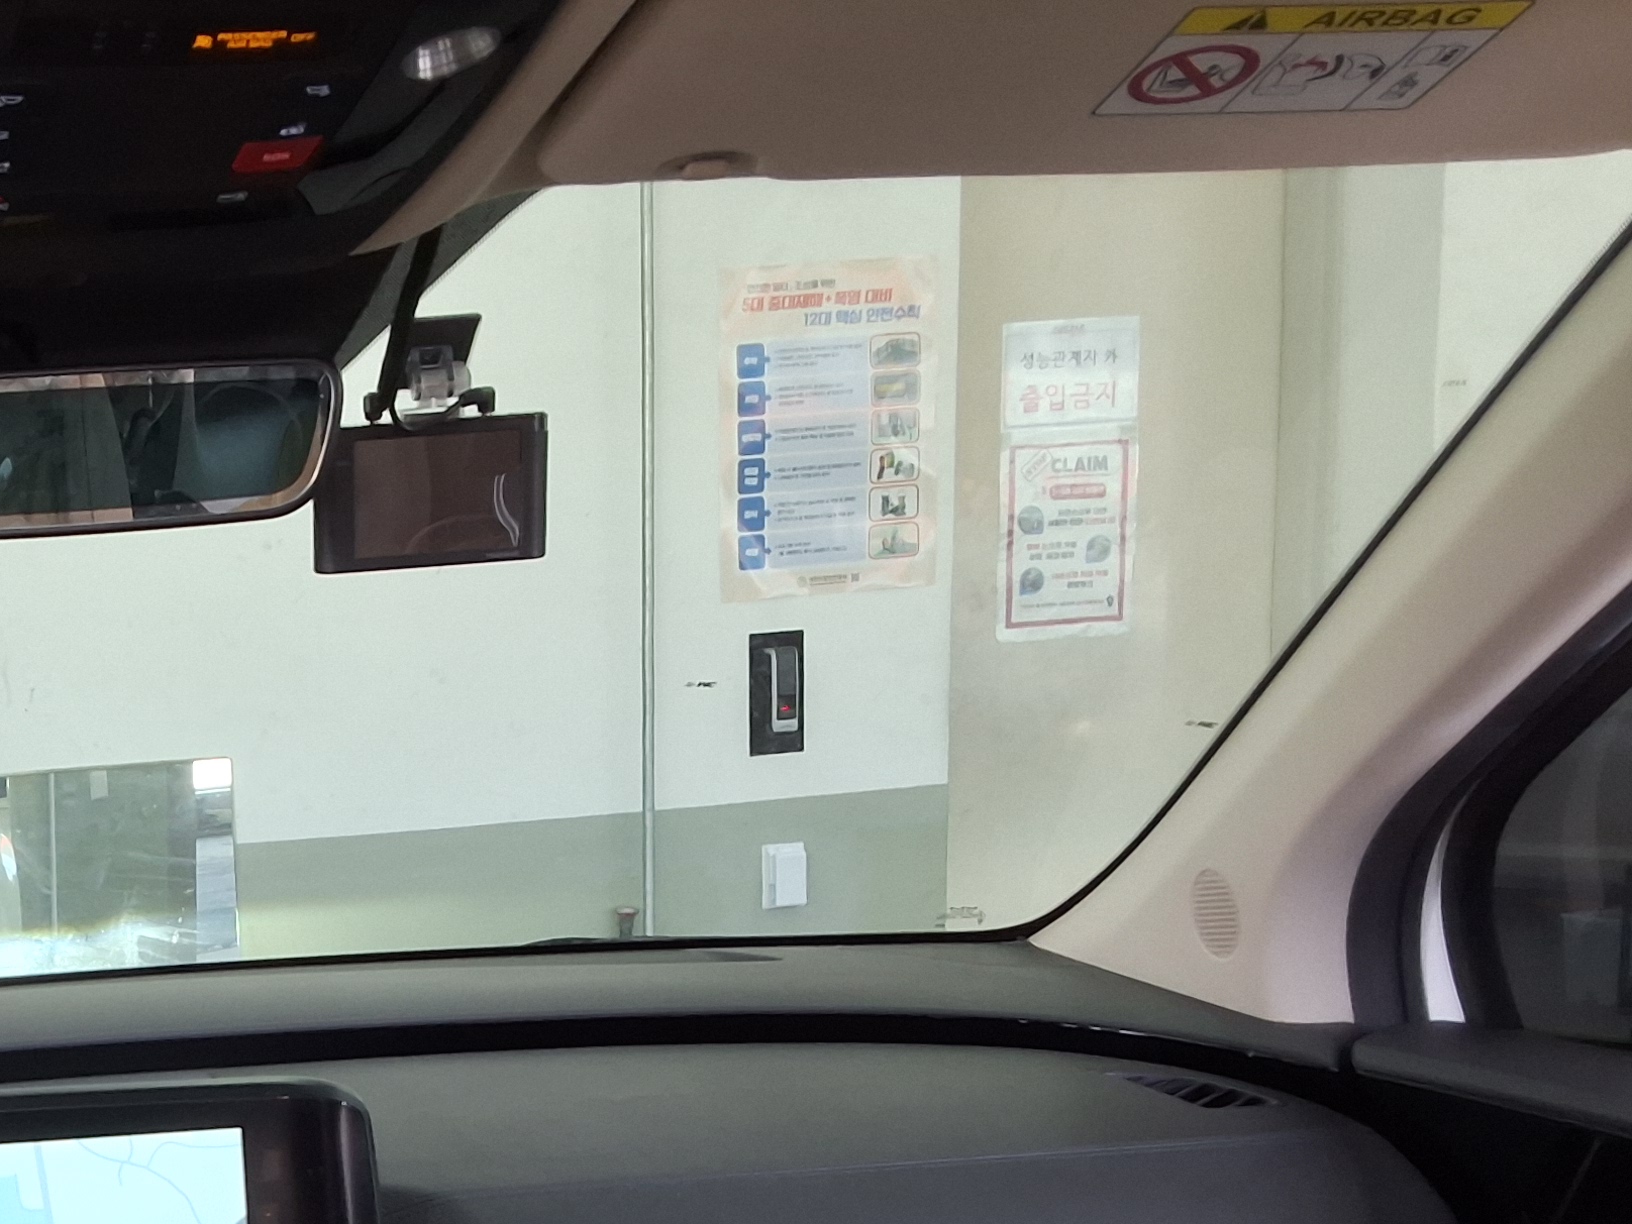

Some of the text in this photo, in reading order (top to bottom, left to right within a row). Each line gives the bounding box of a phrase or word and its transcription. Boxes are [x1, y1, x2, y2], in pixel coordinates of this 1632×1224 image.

[1304, 7, 1482, 28] AIRBAG
[1019, 379, 1116, 414] 출입금지
[1051, 454, 1109, 473] CLAIM
